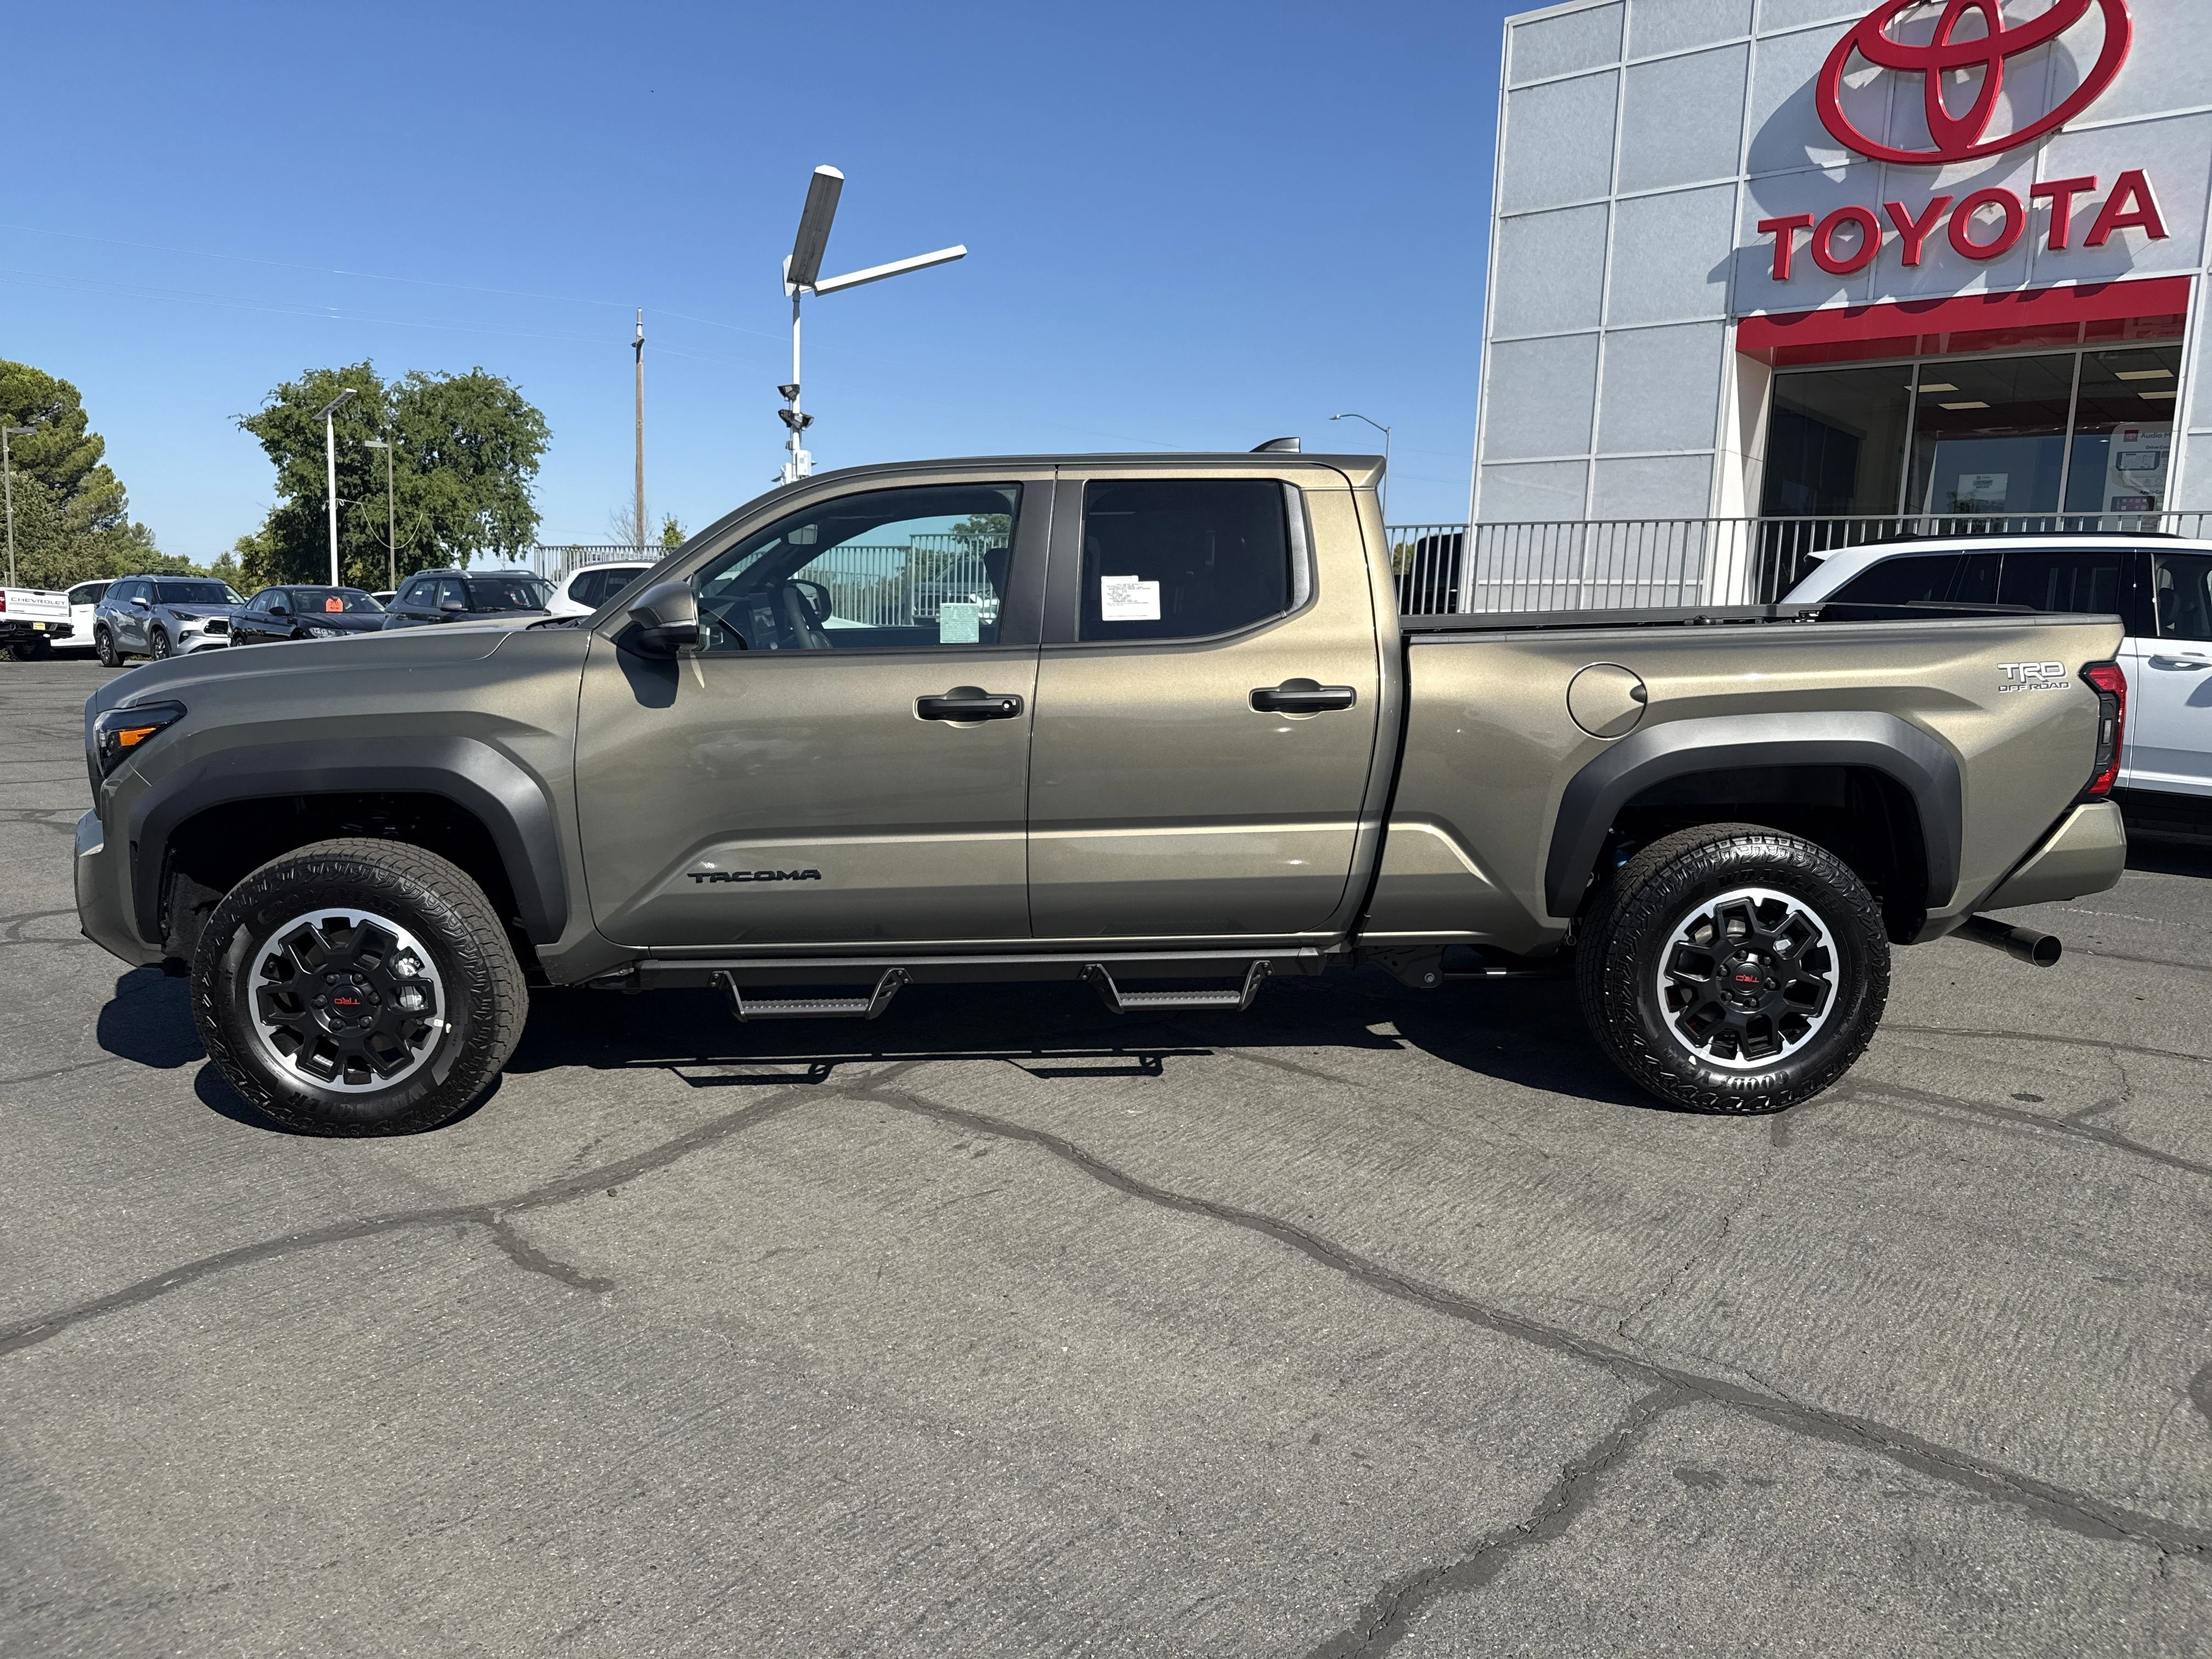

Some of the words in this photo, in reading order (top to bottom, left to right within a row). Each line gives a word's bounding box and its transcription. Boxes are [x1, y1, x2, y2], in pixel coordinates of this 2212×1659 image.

[1758, 168, 2169, 281] TOYOTA
[11, 597, 65, 605] CHEVROLET
[1997, 661, 2068, 682] TRD
[1998, 684, 2028, 693] OFF
[2029, 681, 2070, 691] ROAD
[687, 869, 822, 883] TACOMA
[1717, 868, 1843, 915] WRANGLER
[286, 1082, 429, 1119] WRANGLER
